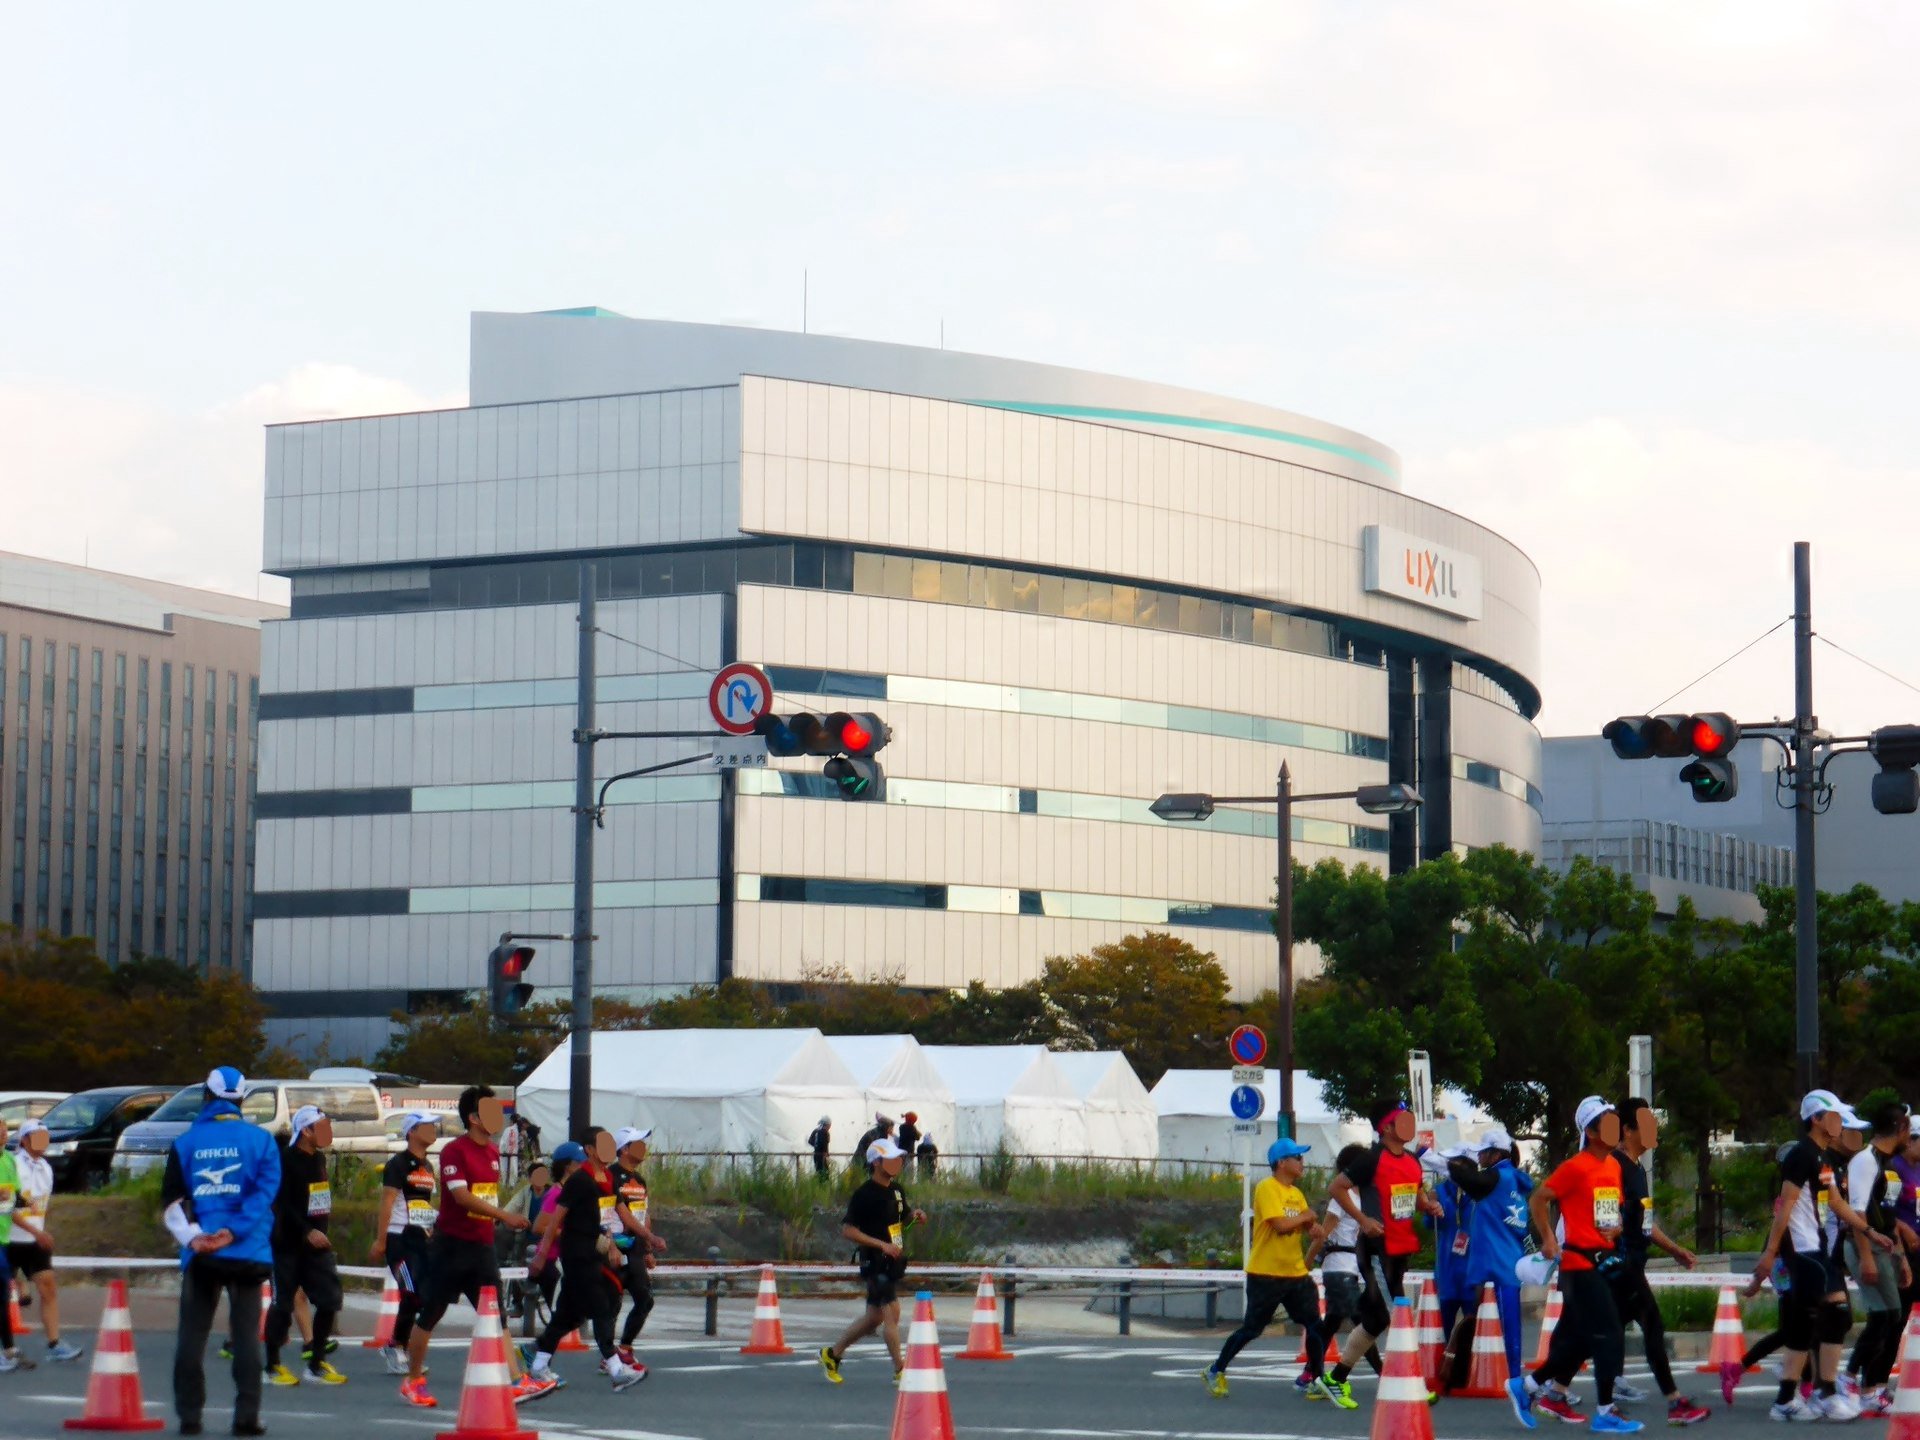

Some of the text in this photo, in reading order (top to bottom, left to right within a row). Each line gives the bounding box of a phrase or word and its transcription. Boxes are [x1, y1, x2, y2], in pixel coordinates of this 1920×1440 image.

[1406, 548, 1457, 598] LIXIL
[715, 754, 766, 765] 交差点内
[1234, 1070, 1263, 1080] ここから
[194, 1147, 240, 1160] OFFICIAL
